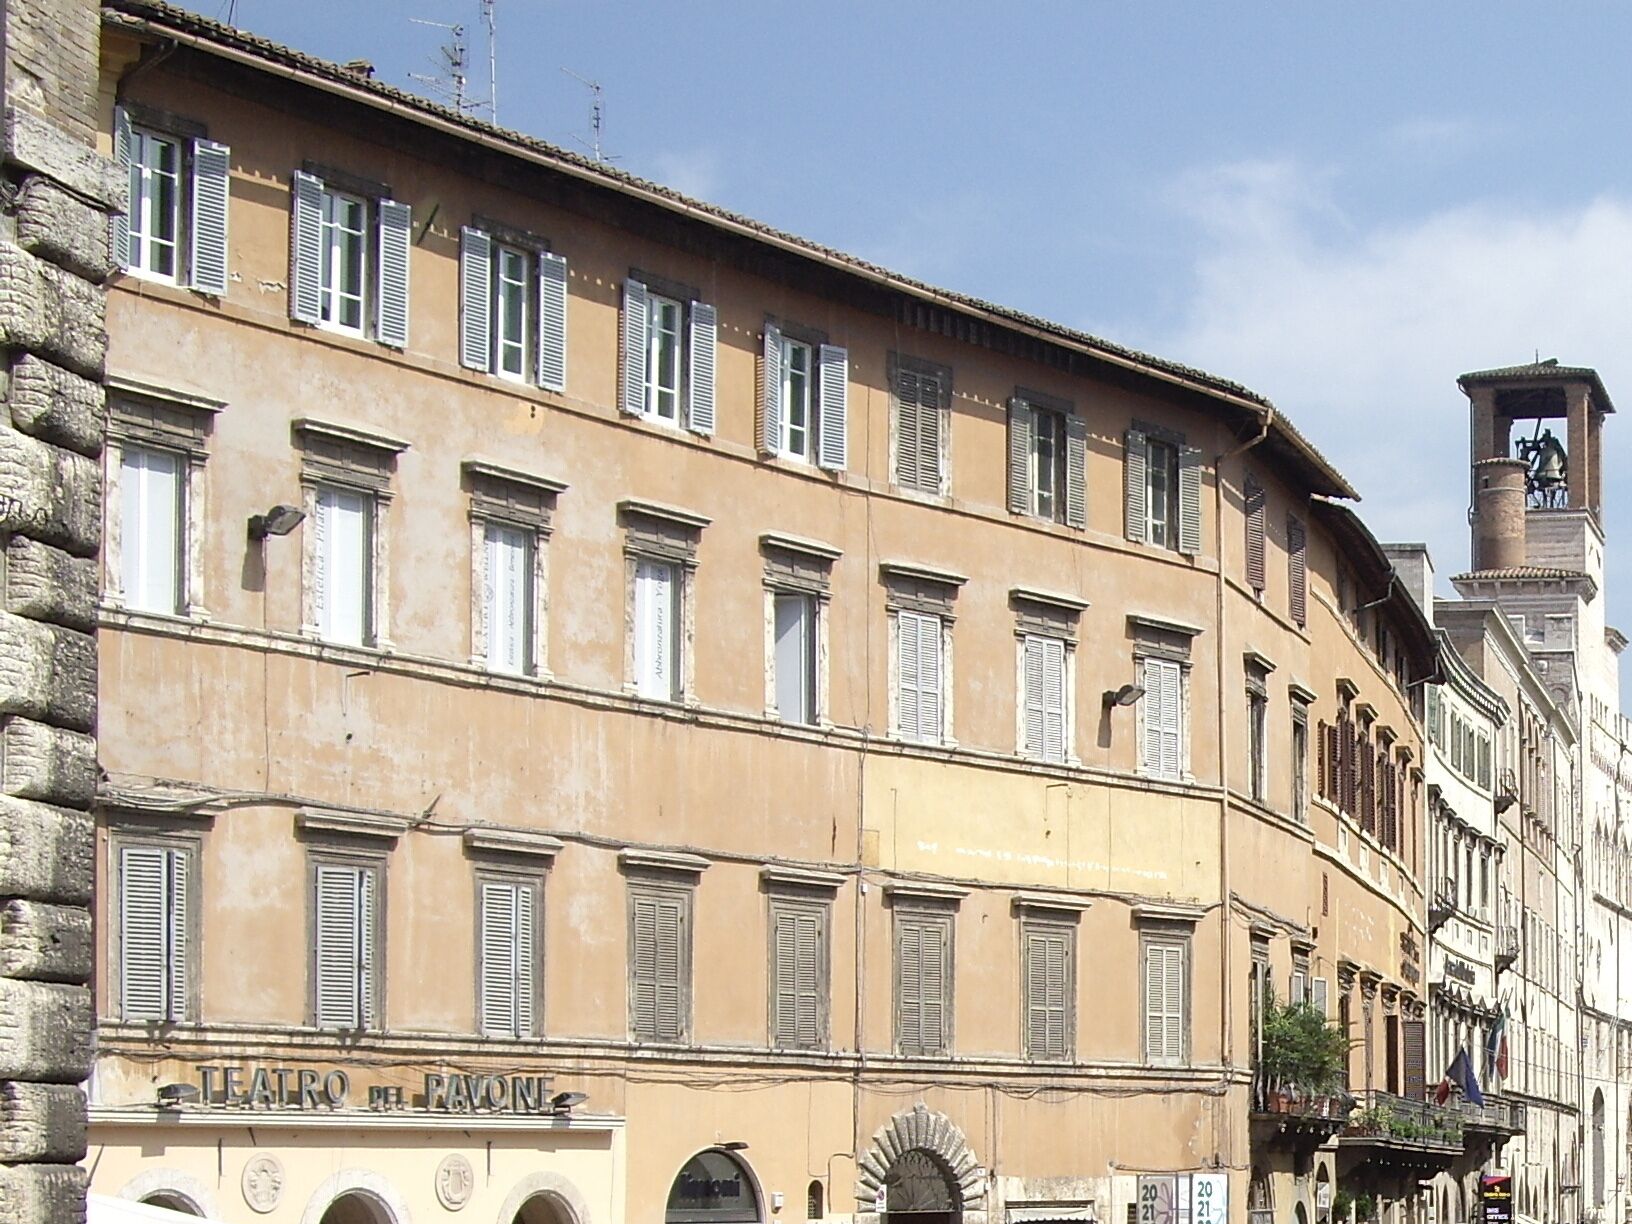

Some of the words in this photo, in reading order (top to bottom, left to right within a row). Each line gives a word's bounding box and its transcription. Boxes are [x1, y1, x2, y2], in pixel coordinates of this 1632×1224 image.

[195, 1065, 349, 1108] TEATRO
[368, 1086, 407, 1109] DEL
[424, 1073, 555, 1113] PAVONE
[1142, 1184, 1158, 1202] 20
[1197, 1180, 1213, 1198] 20
[1142, 1203, 1155, 1221] 21
[1197, 1200, 1210, 1217] 21
